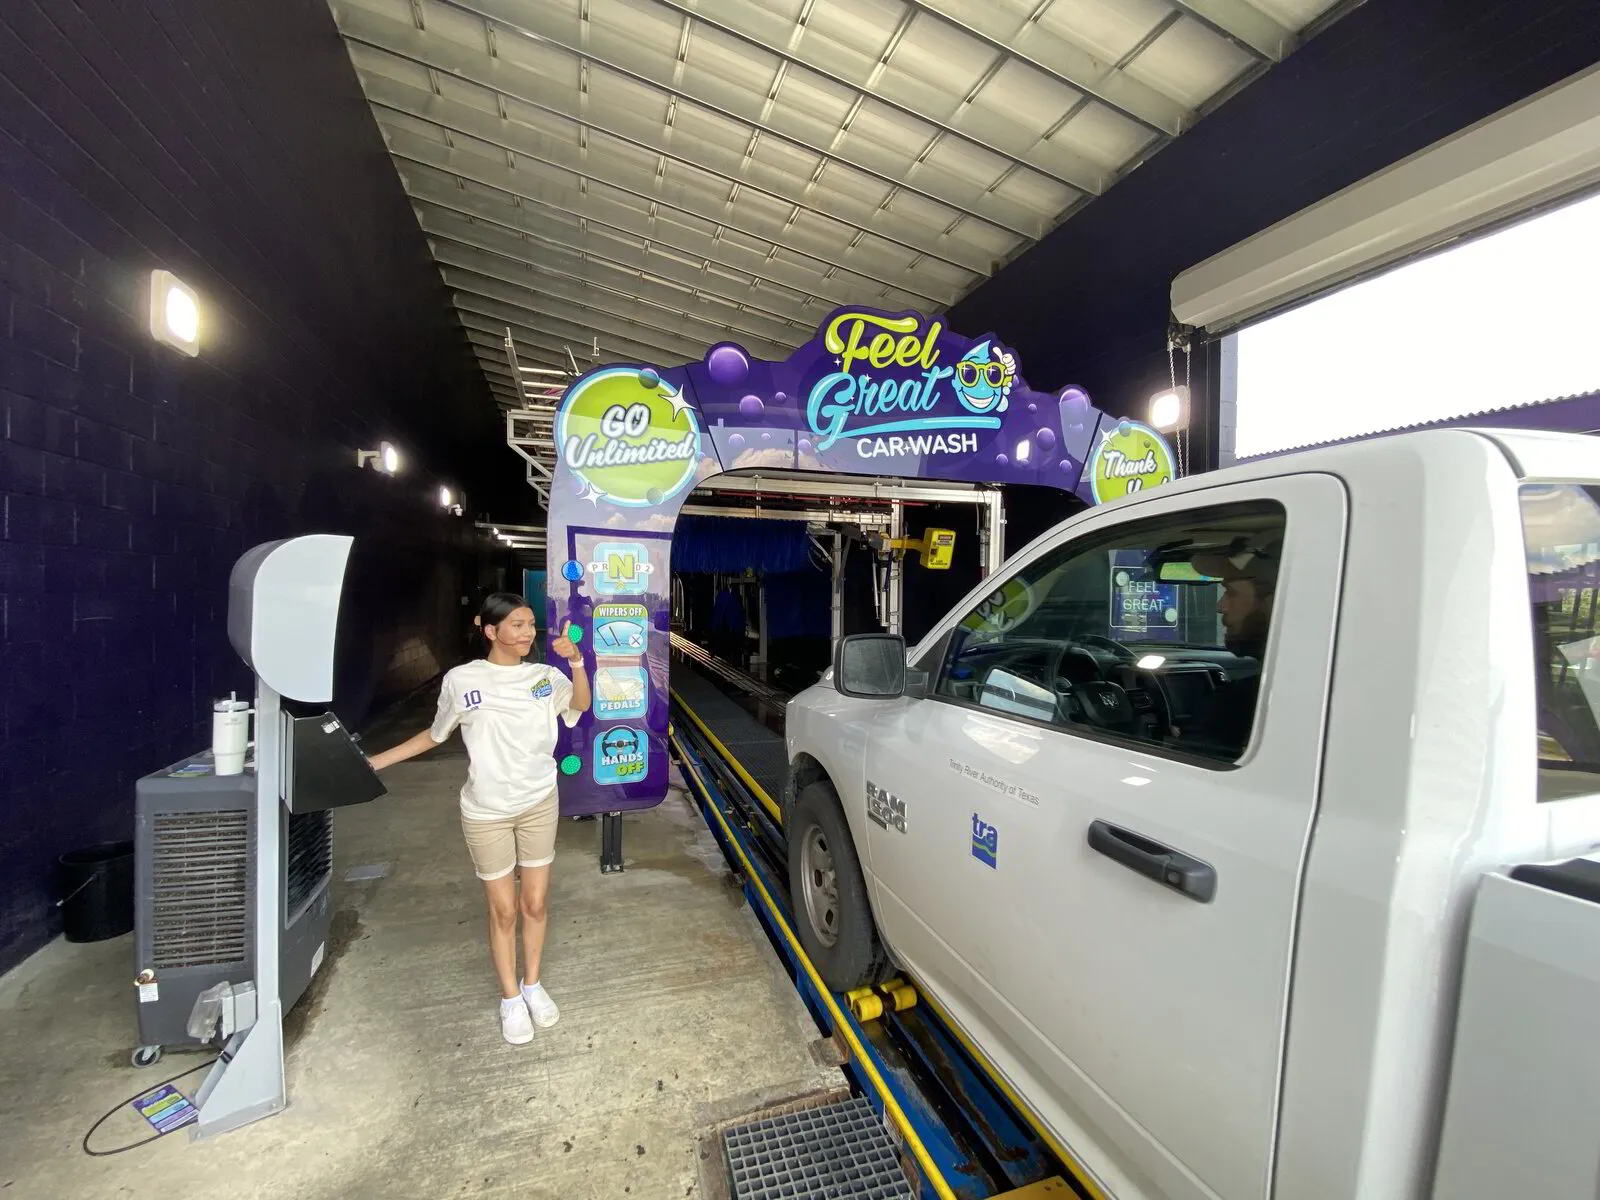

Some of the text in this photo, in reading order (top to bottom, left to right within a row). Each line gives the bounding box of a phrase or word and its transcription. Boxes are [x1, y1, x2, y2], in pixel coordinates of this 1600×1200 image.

[825, 312, 942, 373] Feel
[601, 402, 651, 438] GO
[807, 365, 953, 451] Great
[565, 431, 697, 469] Unlimited
[856, 433, 977, 458] CAR WASH
[1103, 449, 1157, 480] Thank
[592, 563, 598, 571] P
[608, 553, 635, 579] N
[1128, 581, 1159, 593] FEEL
[599, 607, 643, 617] WIPERS OFF
[1123, 599, 1164, 611] GREAT
[464, 690, 482, 708] 10
[600, 699, 641, 711] PEDALS
[601, 752, 643, 766] HANDS
[616, 762, 644, 776] OFF
[964, 765, 979, 778] River
[980, 772, 1008, 794] Authority
[1008, 785, 1017, 795] of
[1018, 787, 1040, 805] Texas
[866, 780, 907, 819] RAM
[867, 795, 908, 834] 1500
[972, 812, 997, 846] tra
